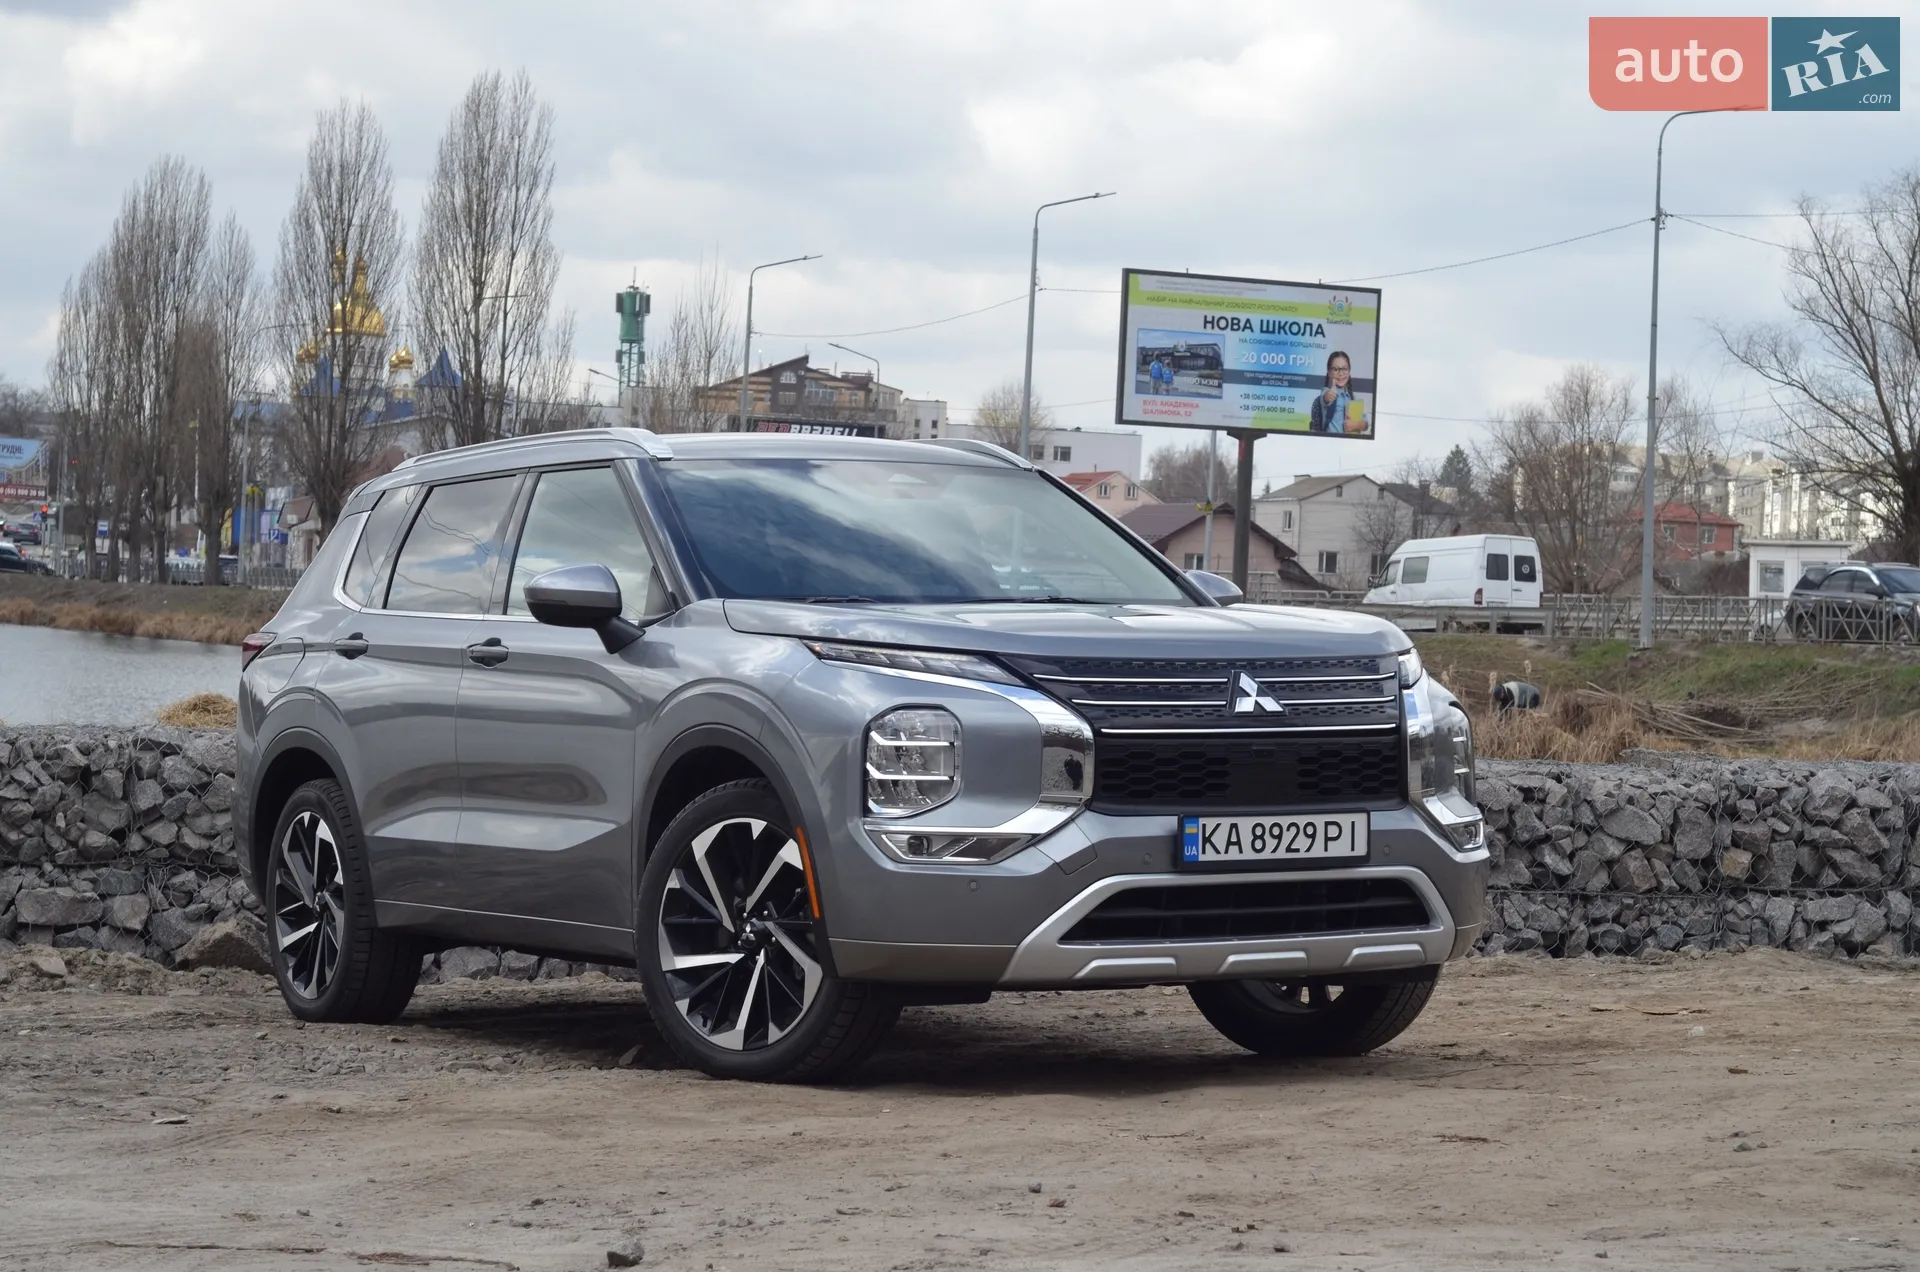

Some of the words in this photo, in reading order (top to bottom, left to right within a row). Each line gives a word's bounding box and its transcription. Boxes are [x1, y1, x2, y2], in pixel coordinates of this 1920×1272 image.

[1203, 314, 1254, 333] НОВА
[1259, 318, 1326, 338] ШКОЛА
[1241, 352, 1257, 364] 20
[1260, 353, 1286, 366] 000
[1289, 355, 1314, 367] ГРН
[1251, 394, 1266, 402] (067)
[1142, 399, 1158, 407] ВУЛ.
[1160, 400, 1200, 409] АКАДЕМІКА
[1239, 404, 1250, 412] +38
[1251, 405, 1266, 413] (097)
[1201, 822, 1243, 855] KA
[1250, 821, 1317, 854] 8929
[1184, 845, 1198, 856] UA
